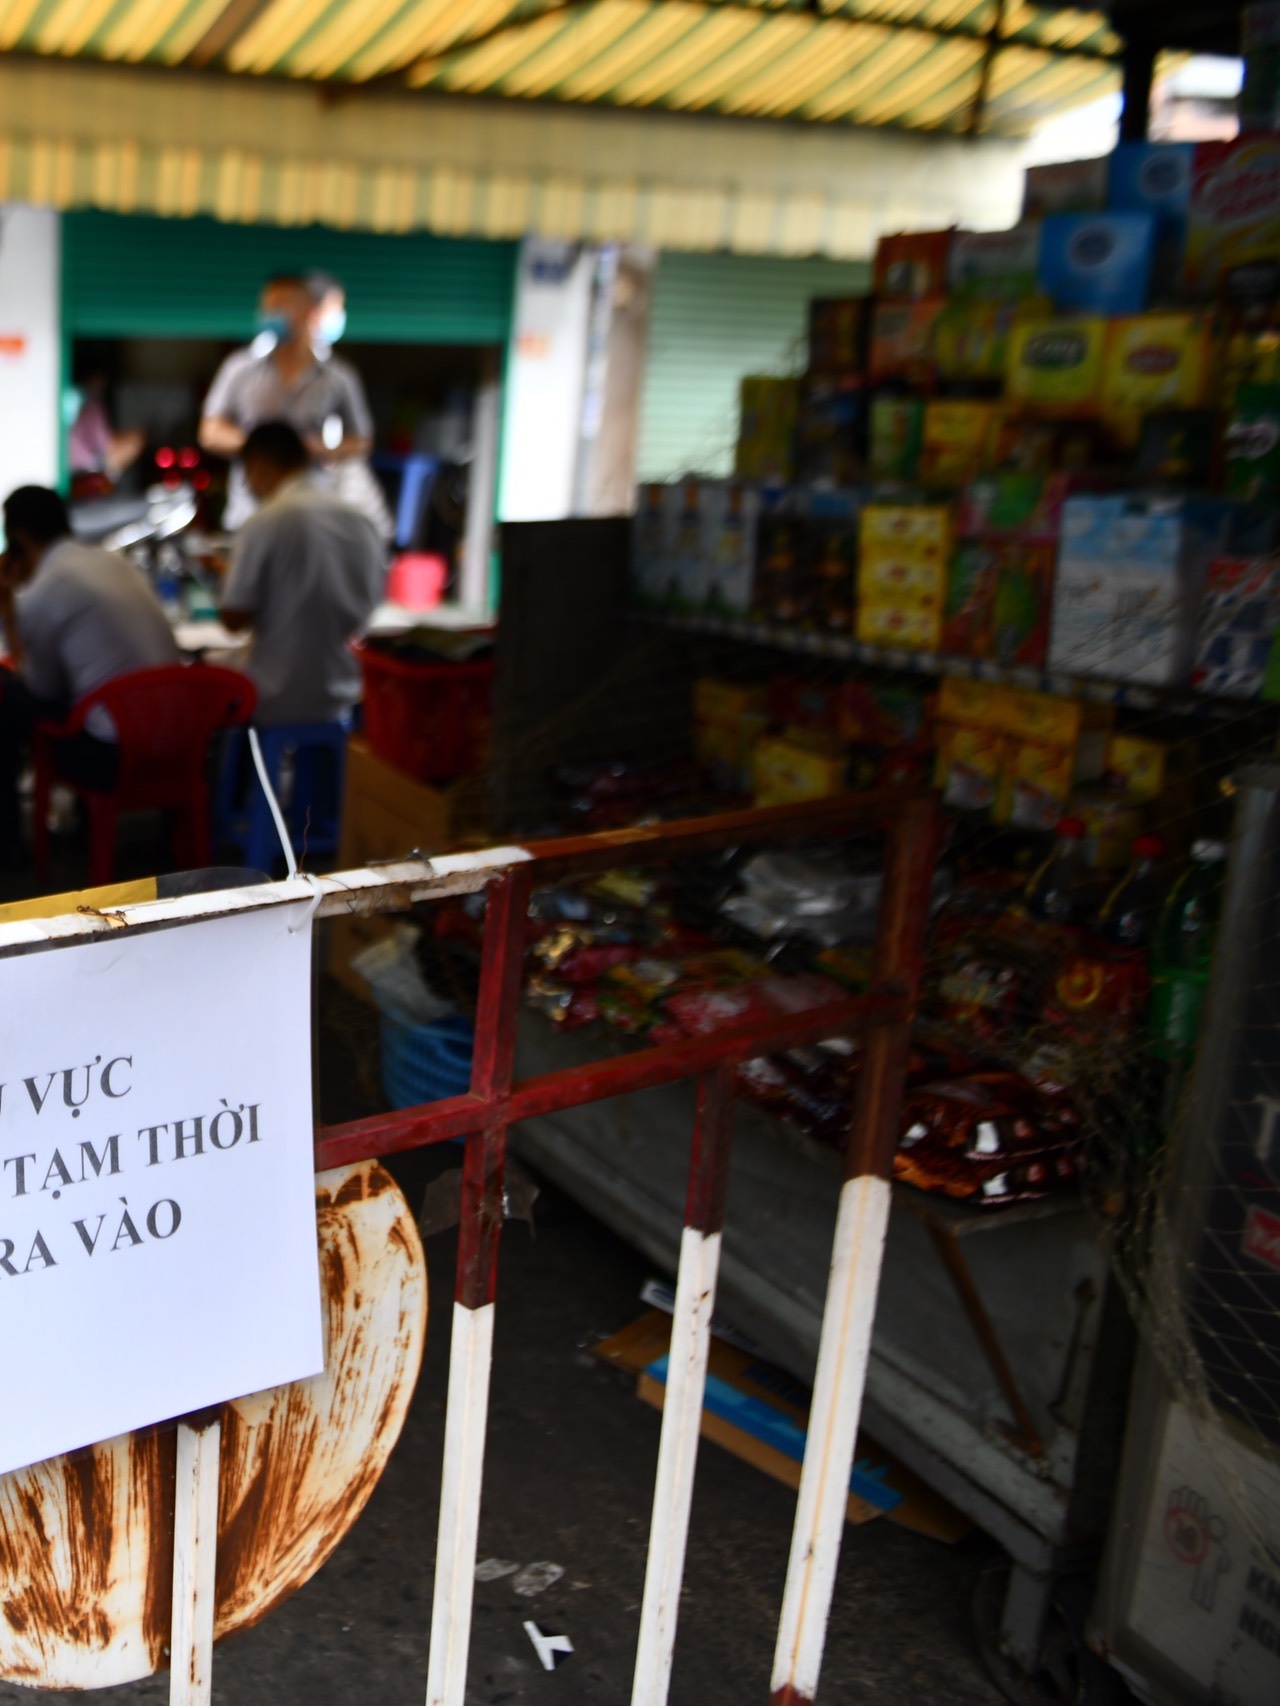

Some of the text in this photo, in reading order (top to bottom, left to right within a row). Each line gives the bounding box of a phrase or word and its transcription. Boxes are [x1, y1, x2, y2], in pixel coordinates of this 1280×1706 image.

[21, 1054, 133, 1119] VỰC
[3, 1133, 124, 1201] TẠM
[137, 1097, 262, 1167] THỜI
[70, 1195, 182, 1258] VÀO
